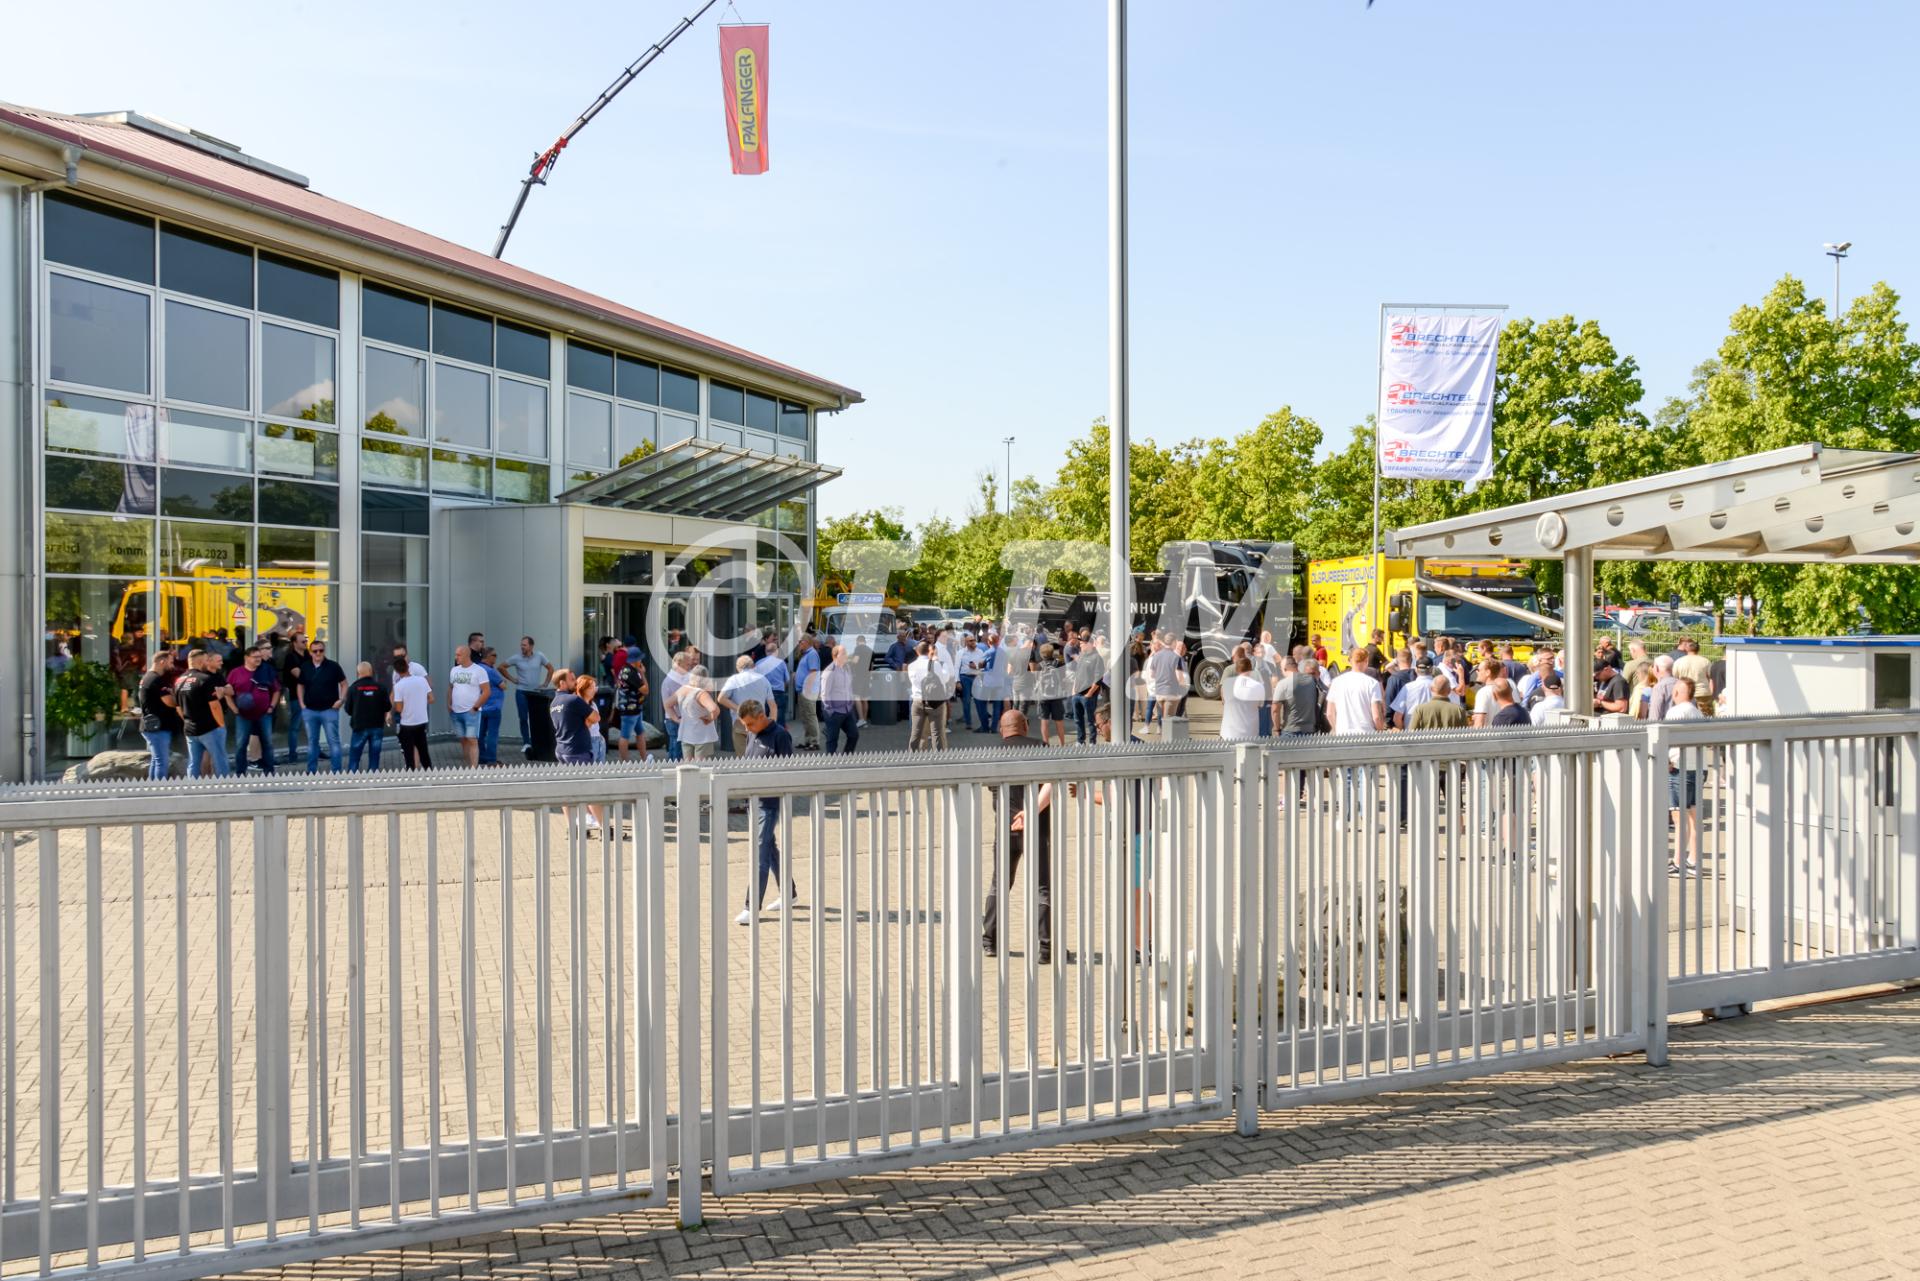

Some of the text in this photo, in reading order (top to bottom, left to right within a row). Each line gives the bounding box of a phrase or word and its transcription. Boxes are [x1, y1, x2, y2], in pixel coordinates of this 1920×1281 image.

[738, 54, 756, 146] PALFINGER
[1406, 333, 1478, 343] BRECHTEL
[1402, 391, 1474, 401] BRECHTEL
[1399, 449, 1472, 459] BRECHTEL
[182, 547, 202, 558] FBA
[204, 548, 228, 560] 2023
[1083, 601, 1167, 615] WACNHUT
